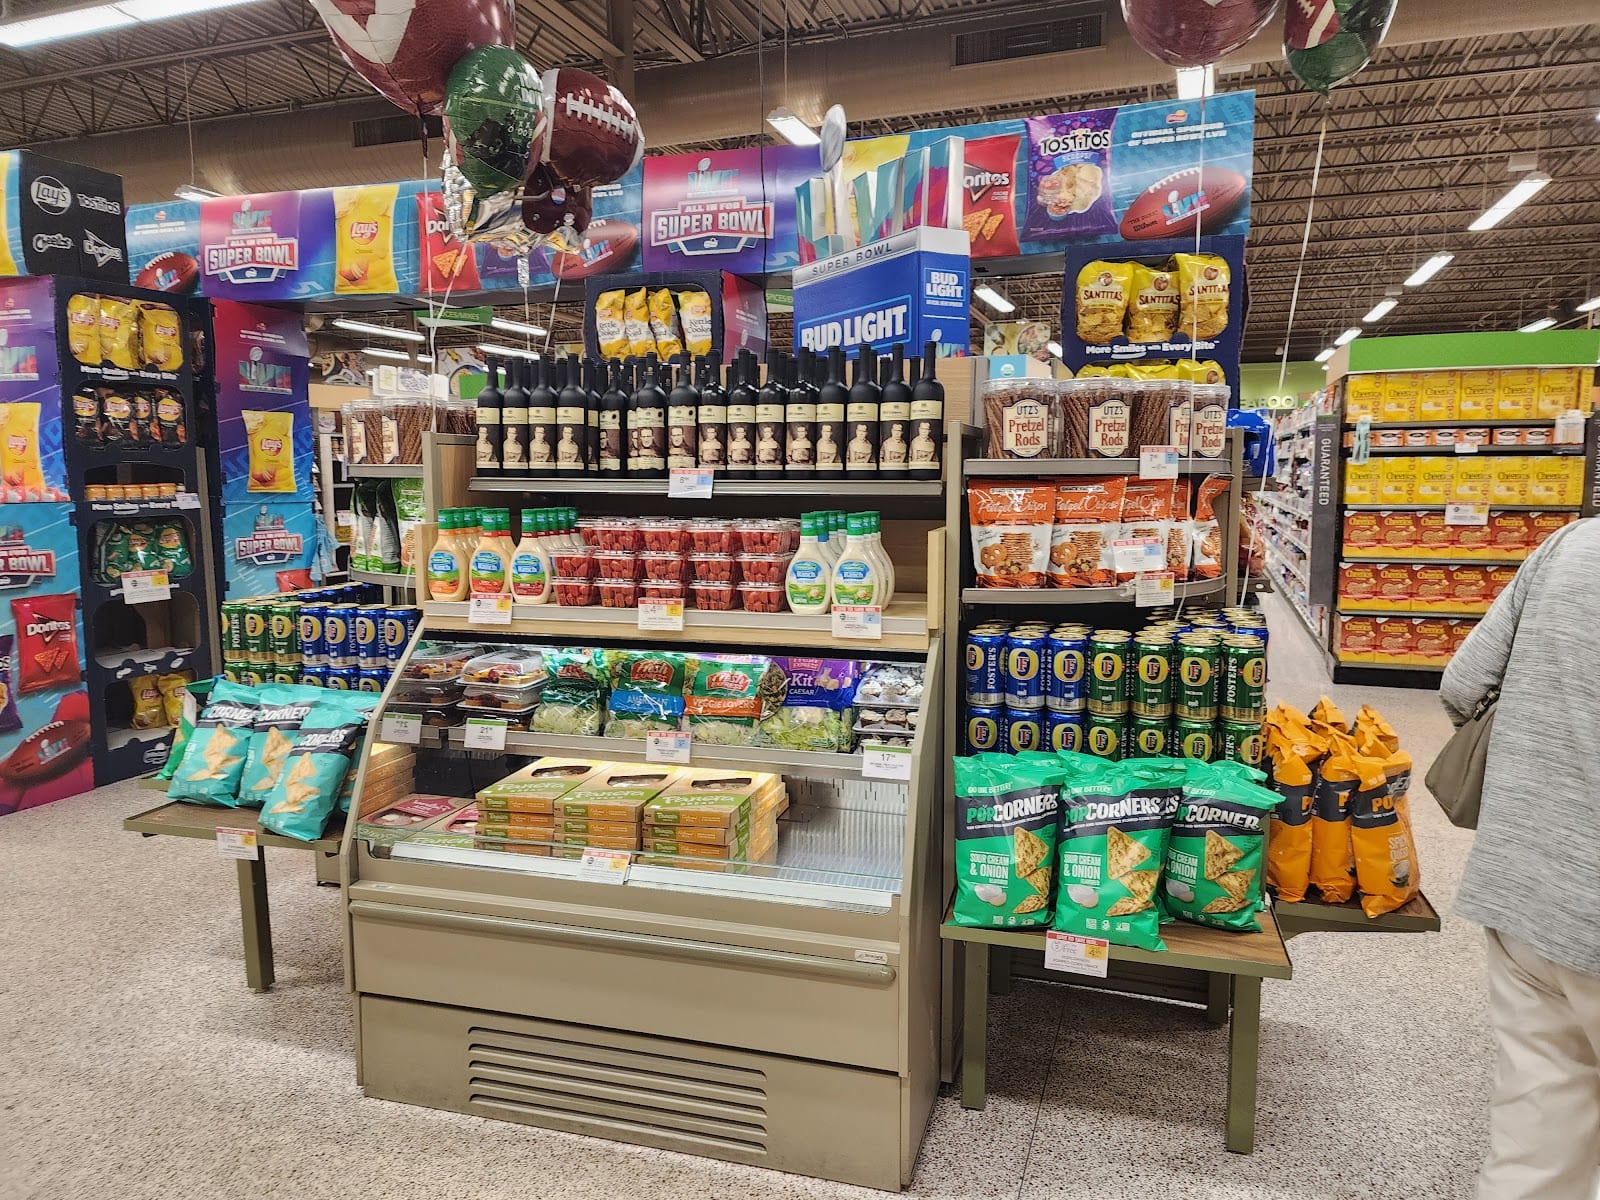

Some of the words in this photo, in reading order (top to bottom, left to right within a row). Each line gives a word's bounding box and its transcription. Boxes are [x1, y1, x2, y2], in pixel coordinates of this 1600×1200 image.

[963, 172, 1010, 188] oritos
[657, 214, 713, 240] SUPER
[718, 210, 765, 232] BOWL
[209, 247, 253, 270] SUPER
[256, 245, 293, 266] BOWL
[812, 257, 850, 276] SUPER
[856, 243, 893, 261] BOWL
[930, 271, 959, 286] BUD
[926, 284, 964, 298] LIGHT
[1084, 289, 1123, 301] SANTITAS
[1139, 294, 1181, 306] SANTITAS
[801, 321, 843, 352] BUD
[844, 304, 907, 347] LIGHT
[1086, 345, 1112, 354] More
[1112, 343, 1146, 353] Smiles
[1162, 342, 1192, 352] Every
[1008, 418, 1044, 433] Pretzel
[1095, 418, 1127, 433] Pretzel
[1015, 432, 1040, 447] Rods
[1101, 432, 1124, 447] Rods
[1318, 437, 1331, 506] GUARANTEED
[239, 540, 272, 556] SUPER
[273, 537, 300, 551] BOWL
[9, 555, 50, 572] BOWL
[26, 620, 71, 637] Doritos
[636, 661, 669, 675] Fresh
[987, 647, 997, 690] FOSTER'S
[711, 672, 745, 684] Fresh
[790, 672, 814, 687] Kit
[1226, 657, 1238, 704] FOSTER'S
[789, 688, 815, 696] CAESAR
[692, 698, 722, 708] VEGGIE
[966, 793, 1058, 824] POPCORNERS
[970, 853, 986, 863] SOUR
[987, 854, 1009, 865] CREAM
[1079, 855, 1102, 866] CREAM
[1177, 853, 1199, 866] CREAM
[969, 862, 978, 876] &
[979, 863, 1009, 879] ONION
[1071, 864, 1101, 880] ONION
